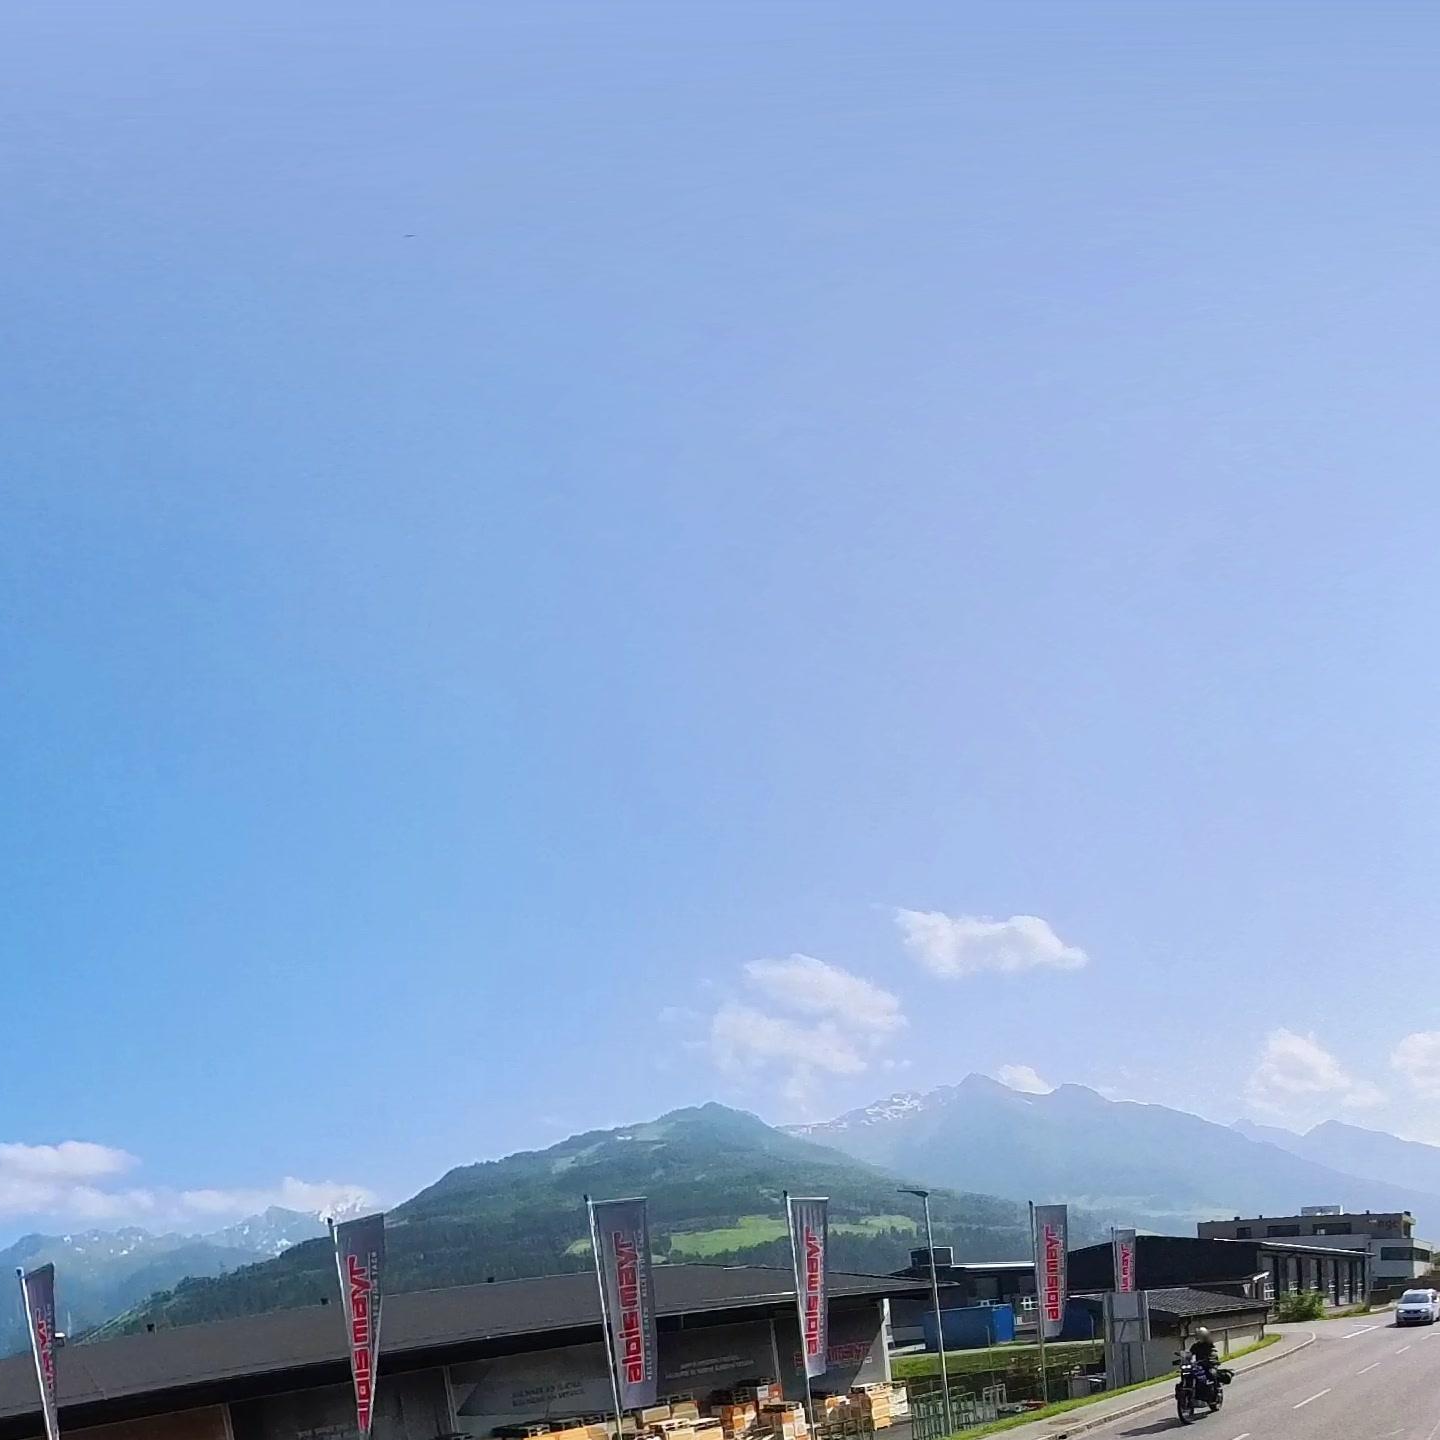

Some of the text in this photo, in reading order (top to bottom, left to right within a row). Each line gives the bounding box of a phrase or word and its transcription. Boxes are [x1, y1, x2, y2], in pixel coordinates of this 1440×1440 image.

[346, 1254, 372, 1346] mayr
[613, 1230, 645, 1385] alois mayr
